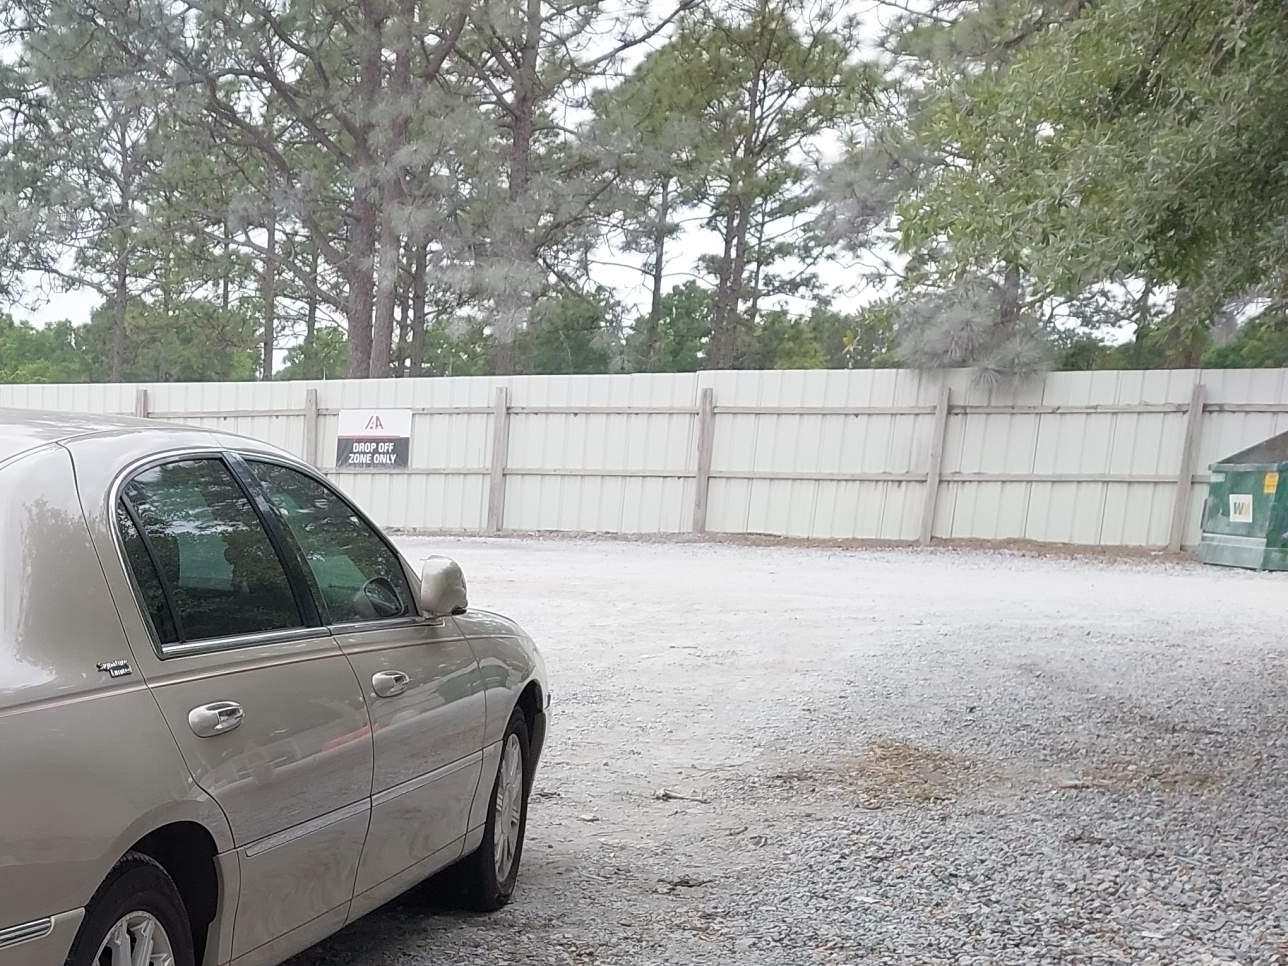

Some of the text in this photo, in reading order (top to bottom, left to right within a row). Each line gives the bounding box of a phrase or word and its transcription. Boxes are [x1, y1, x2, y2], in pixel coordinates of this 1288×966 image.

[353, 442, 394, 453] DROP OFF
[348, 453, 396, 464] ZONE ONLY
